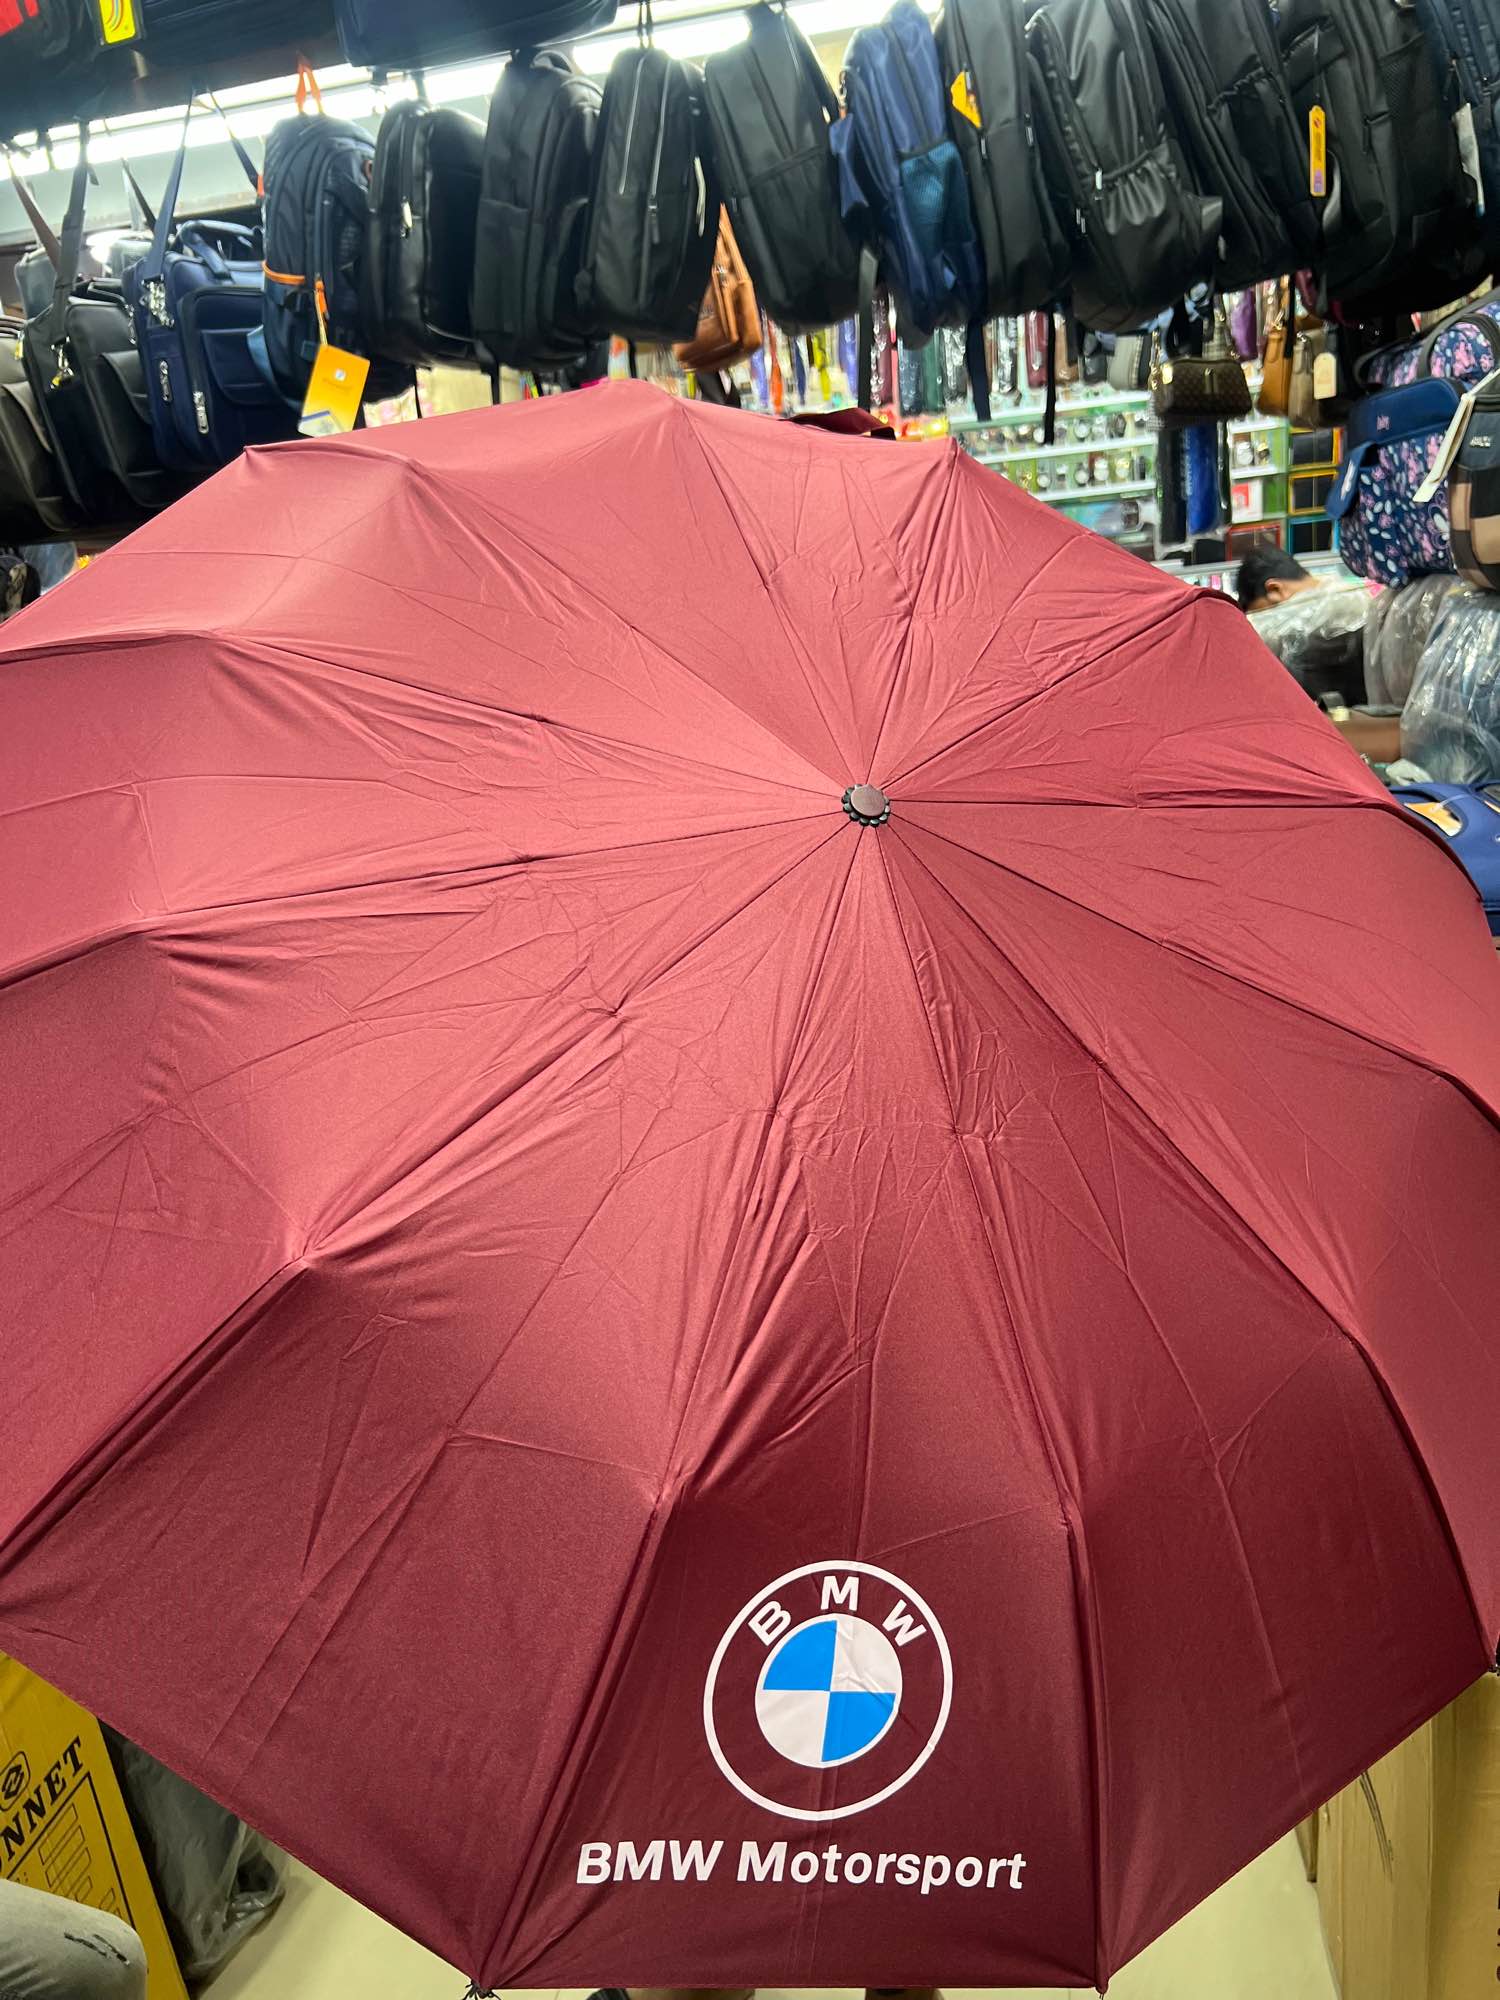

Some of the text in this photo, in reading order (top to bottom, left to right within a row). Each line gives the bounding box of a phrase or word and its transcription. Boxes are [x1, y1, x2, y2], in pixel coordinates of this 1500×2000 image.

[747, 1575, 927, 1647] BMW
[0, 1736, 83, 1873] NNET
[576, 1839, 1027, 1895] BMW Motorsport
